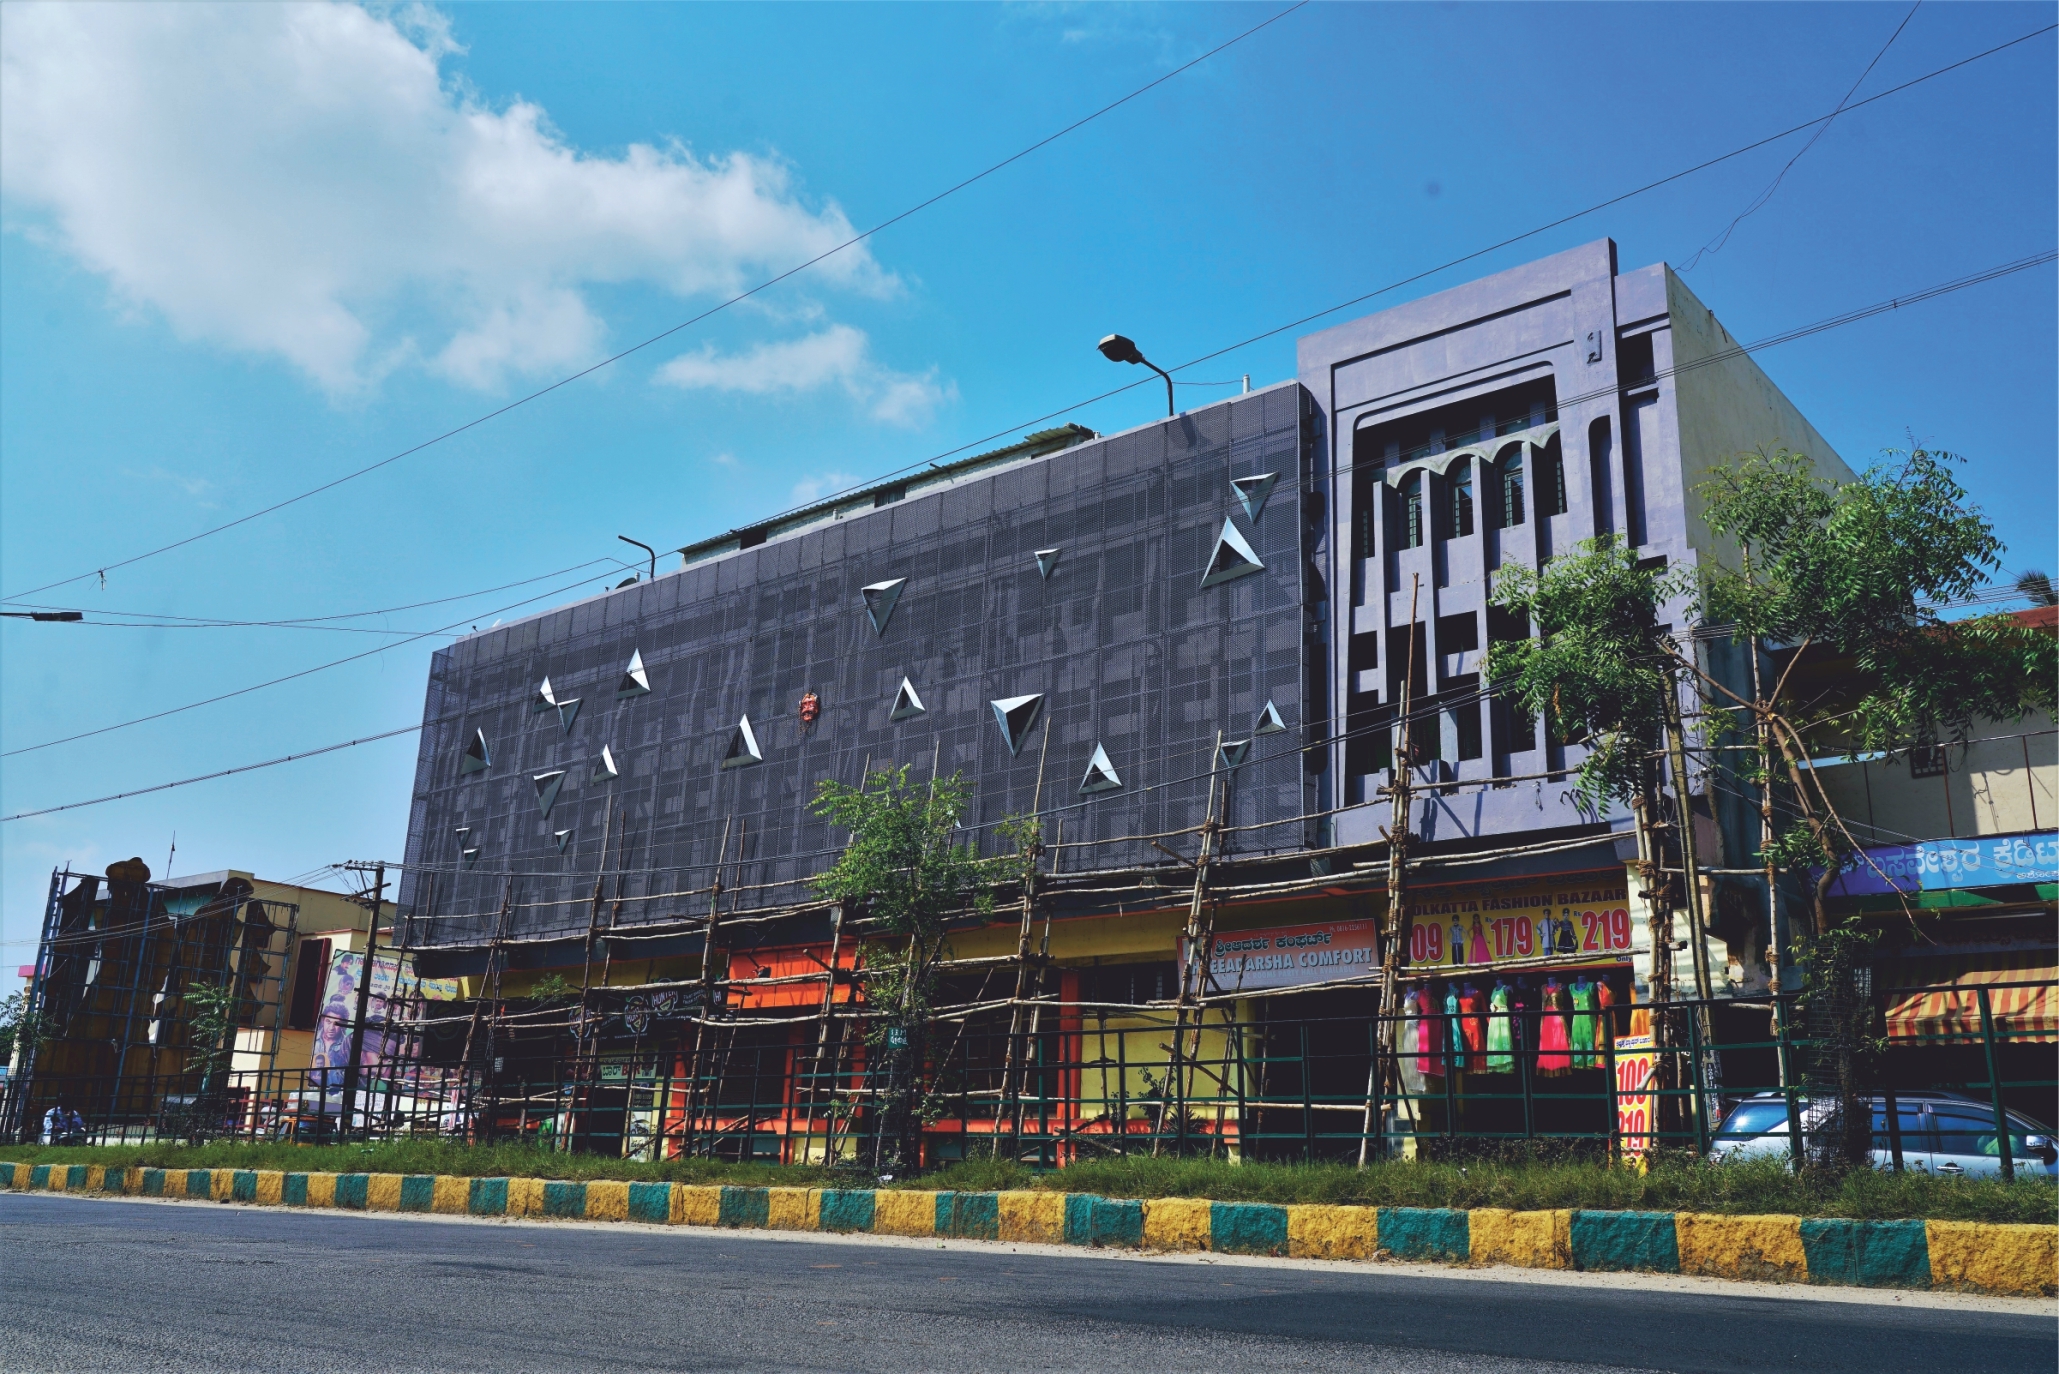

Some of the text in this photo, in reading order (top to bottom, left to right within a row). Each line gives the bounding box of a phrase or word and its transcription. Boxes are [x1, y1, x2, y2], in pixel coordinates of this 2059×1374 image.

[1411, 888, 1627, 916] OLKATTA FASHION BAZAAR
[1410, 922, 1444, 962] 09
[1491, 915, 1534, 957] 179
[1582, 908, 1632, 952] 219
[1278, 968, 1299, 978] PARTY
[1298, 947, 1373, 968] COMFORT
